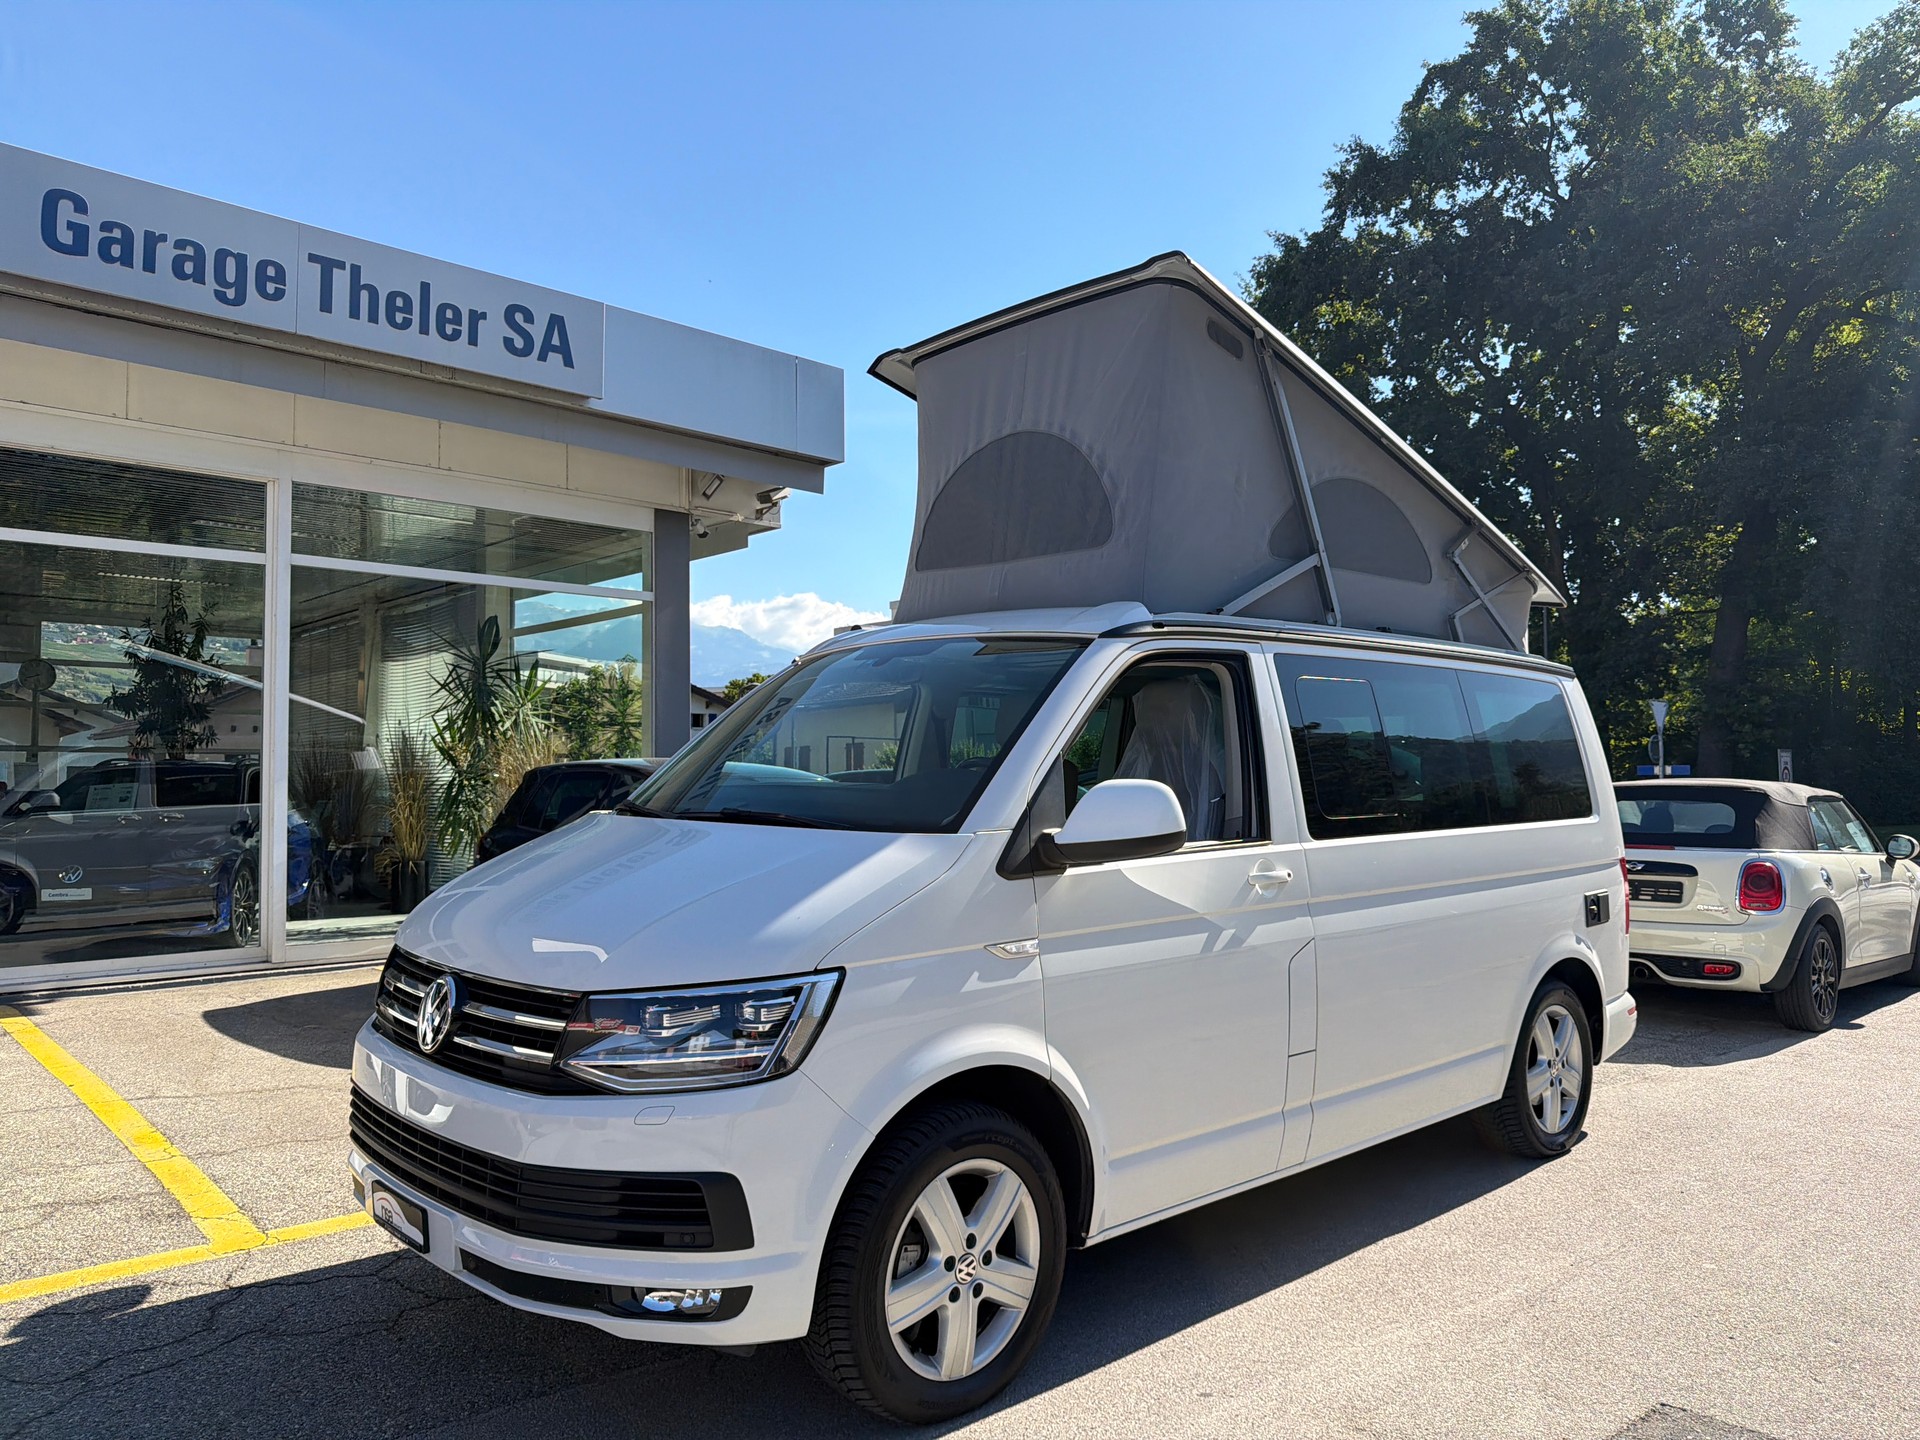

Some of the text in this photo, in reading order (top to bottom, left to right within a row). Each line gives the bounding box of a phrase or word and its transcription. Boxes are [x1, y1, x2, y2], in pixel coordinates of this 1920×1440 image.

[40, 188, 575, 370] Garage Theler SA
